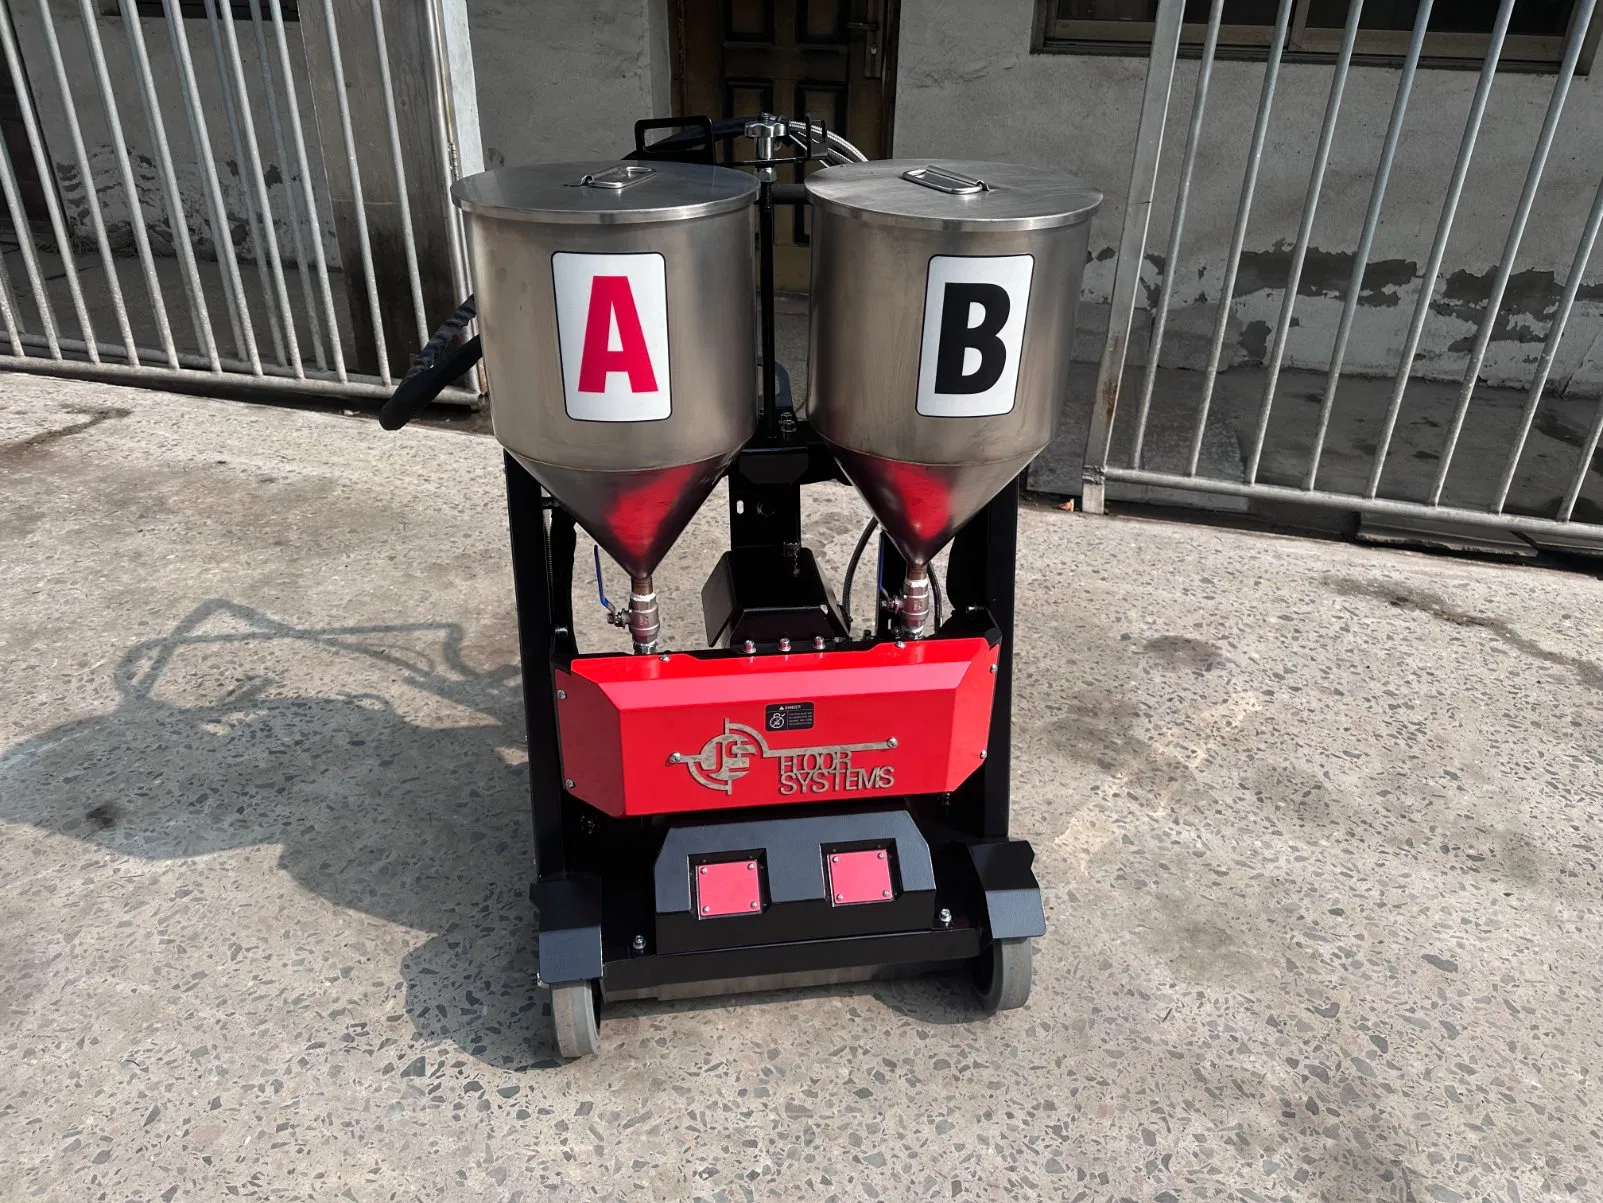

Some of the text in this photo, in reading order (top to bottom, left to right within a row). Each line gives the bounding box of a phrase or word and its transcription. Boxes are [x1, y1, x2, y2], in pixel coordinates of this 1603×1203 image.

[578, 275, 659, 393] A
[934, 282, 1011, 395] B
[780, 751, 852, 774] FLOOR
[780, 766, 895, 795] SYSTEMS
